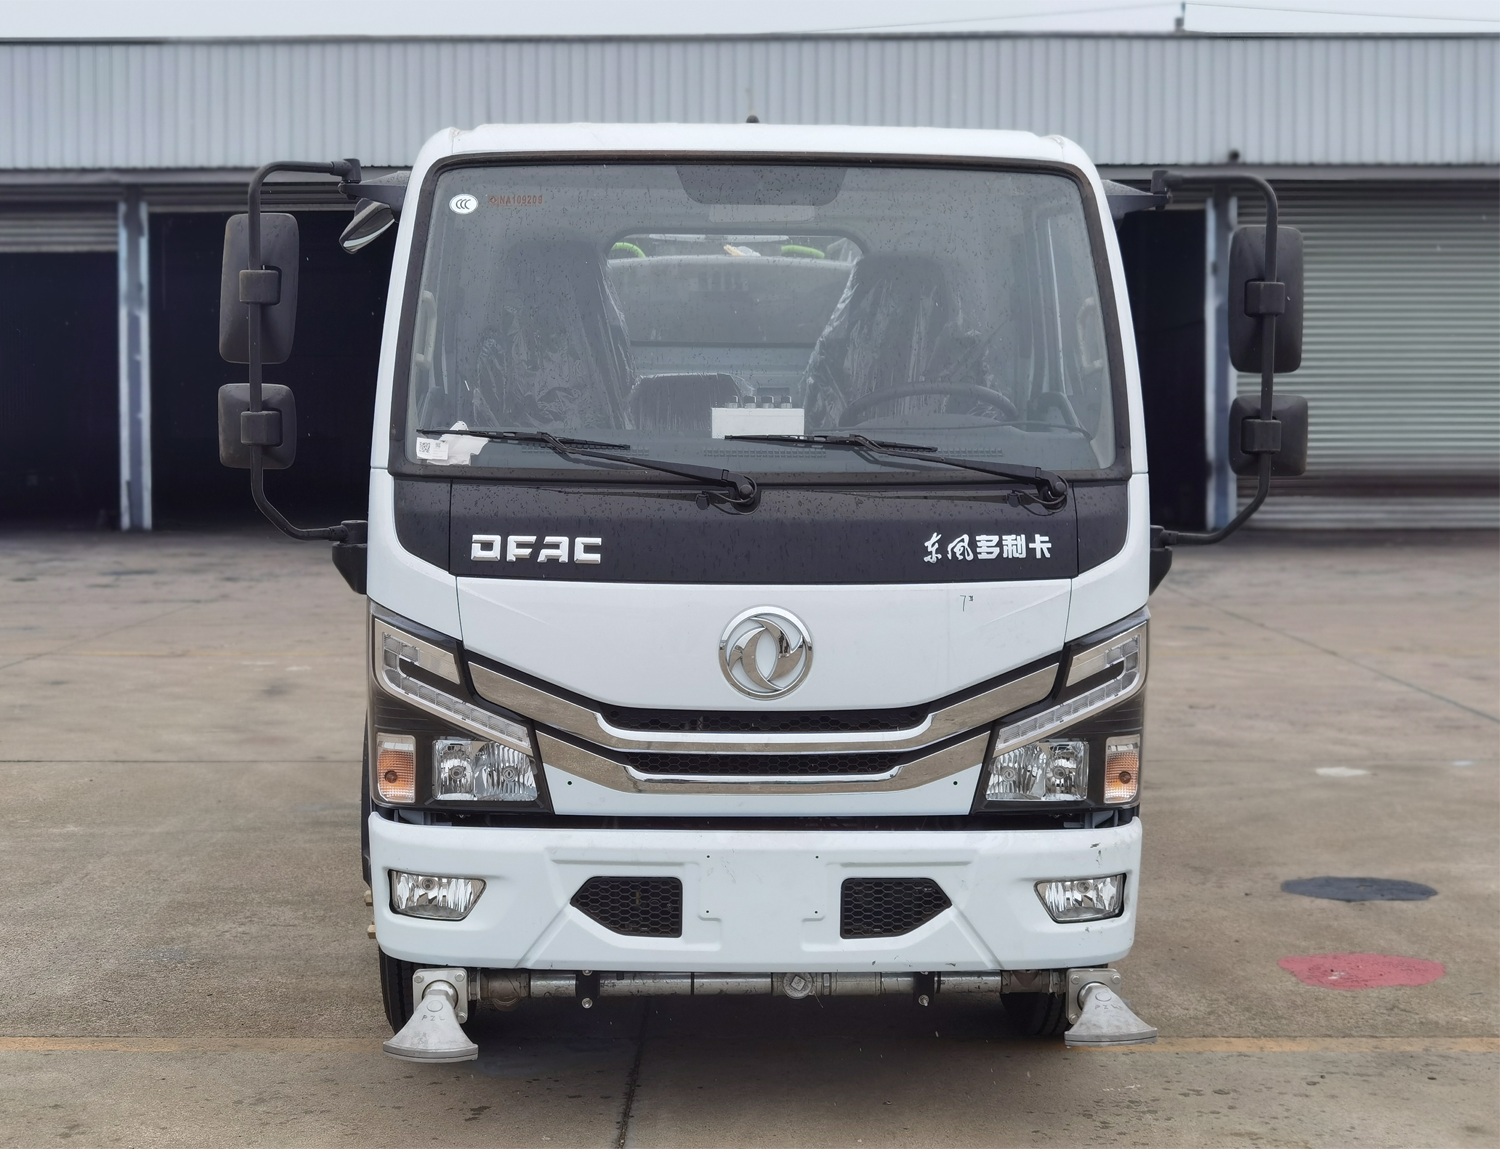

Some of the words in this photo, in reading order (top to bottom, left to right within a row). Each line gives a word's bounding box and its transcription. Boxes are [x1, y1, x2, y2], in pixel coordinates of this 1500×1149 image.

[471, 534, 602, 564] DFAC
[923, 531, 1052, 564] 东风多利卡
